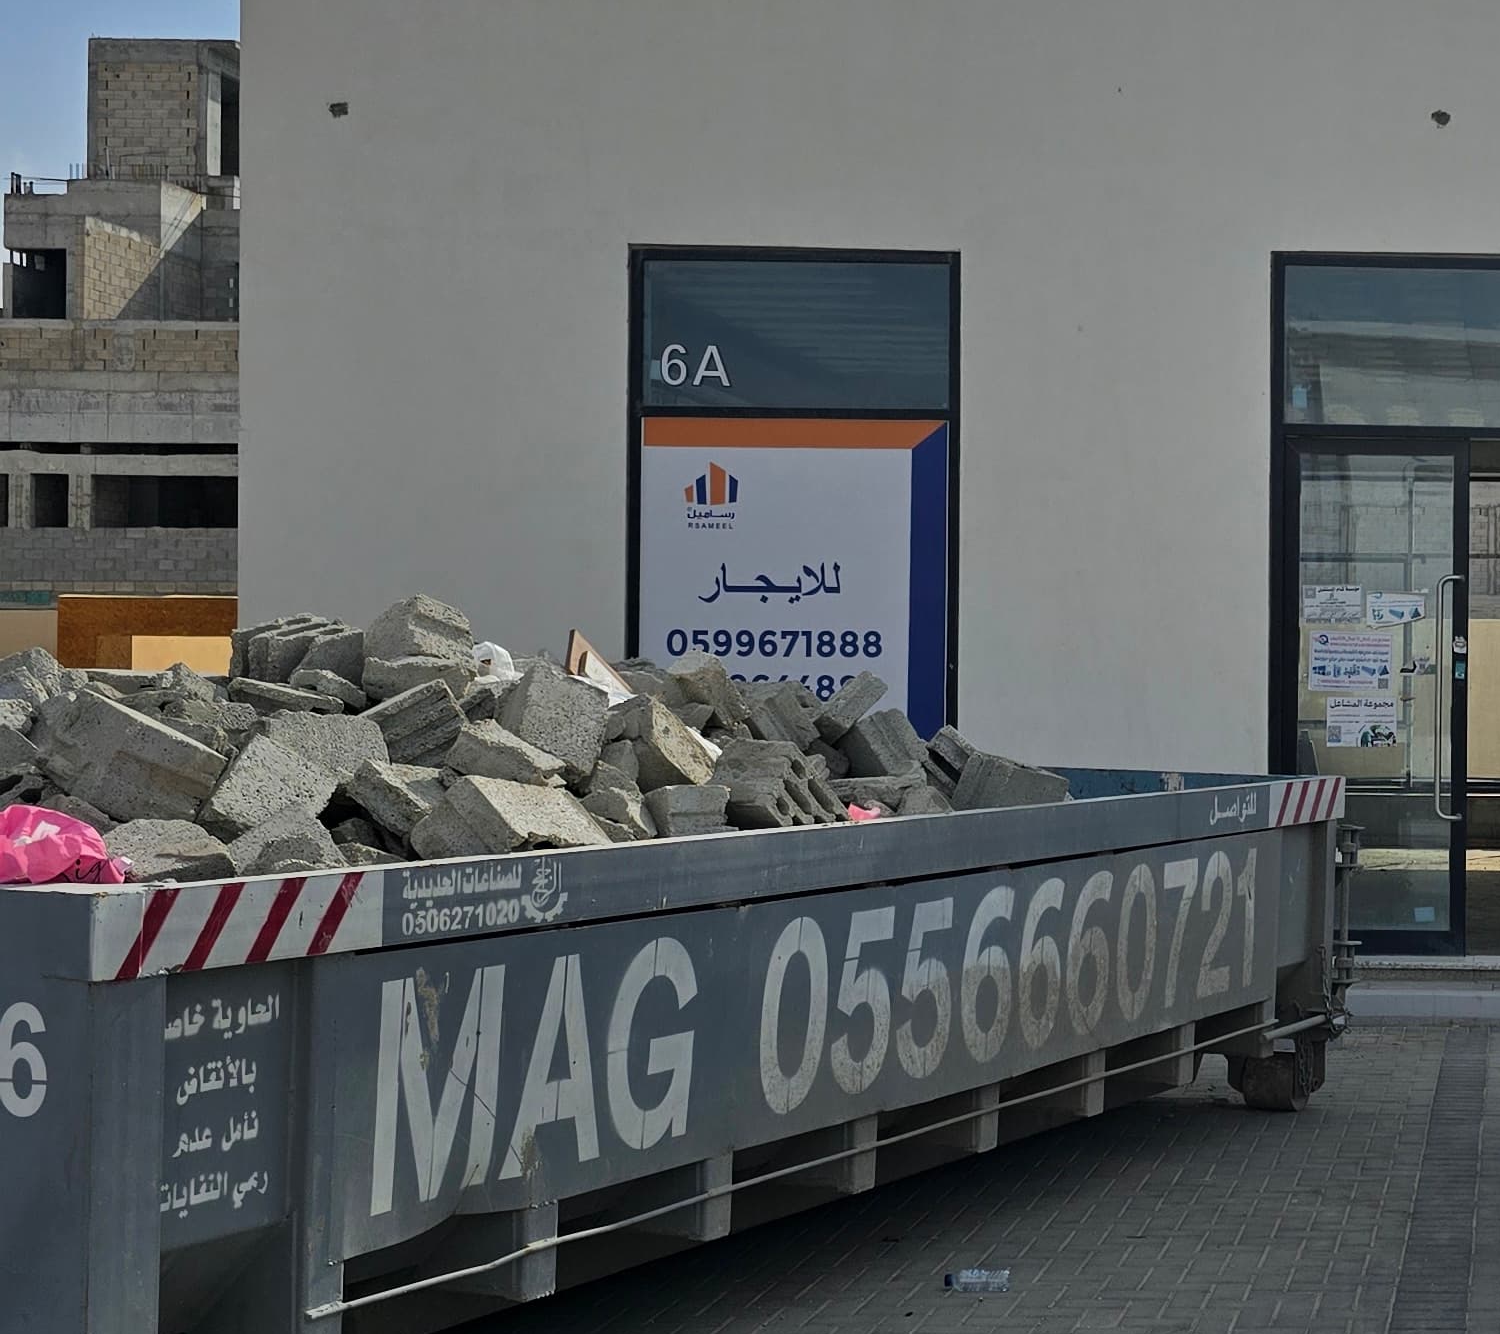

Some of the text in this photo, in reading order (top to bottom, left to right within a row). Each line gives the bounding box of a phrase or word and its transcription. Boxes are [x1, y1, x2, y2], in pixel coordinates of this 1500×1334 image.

[659, 343, 731, 387] 6A
[666, 628, 883, 658] 0599671888
[1363, 699, 1394, 710] مجموعة
[1209, 791, 1257, 826] للتواصل
[401, 899, 520, 936] 0506271020
[212, 992, 280, 1040] الحاوية
[369, 847, 1258, 1217] MAG 0556660721
[0, 1001, 47, 1117] 6
[172, 1109, 260, 1158] نأمل عدم
[232, 1170, 268, 1210] رمي
